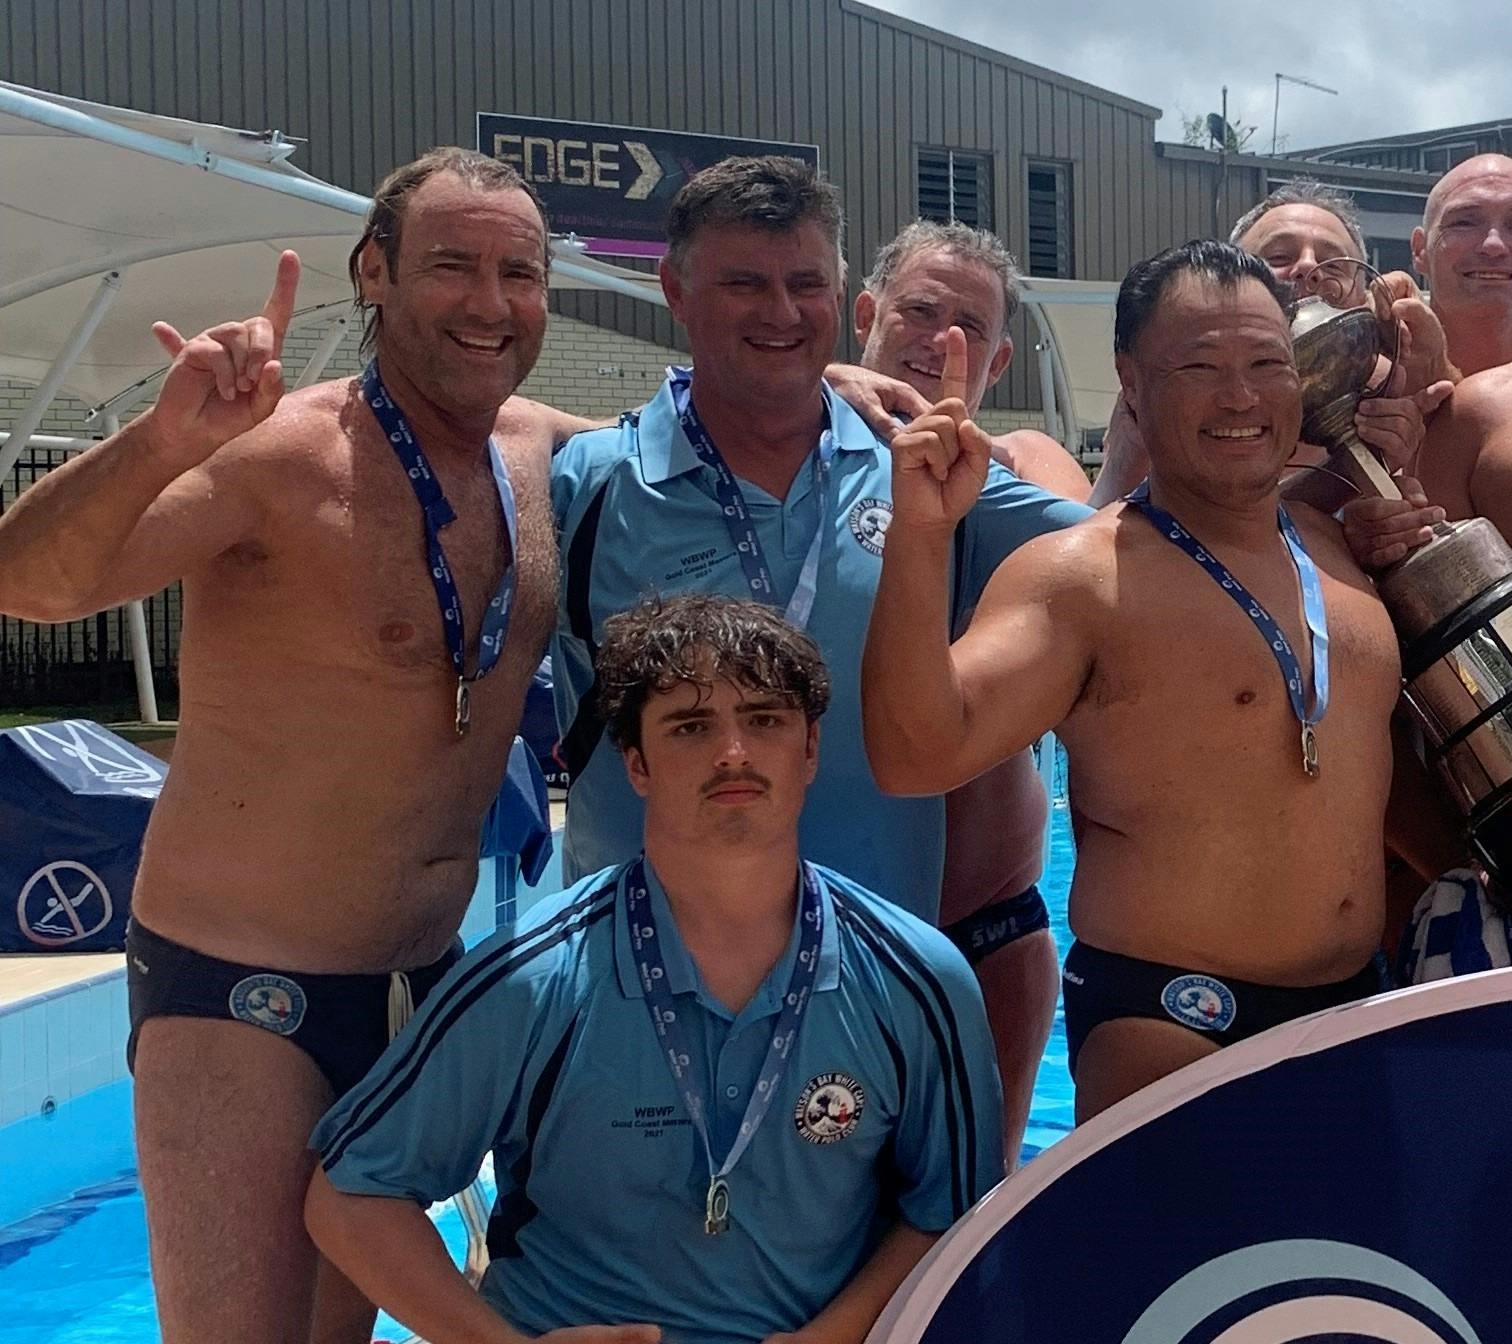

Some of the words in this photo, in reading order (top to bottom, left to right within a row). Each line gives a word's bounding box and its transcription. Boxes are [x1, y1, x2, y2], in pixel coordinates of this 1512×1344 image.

[494, 133, 620, 189] EDGE
[680, 547, 717, 566] WBWP
[634, 1105, 676, 1118] WBWP
